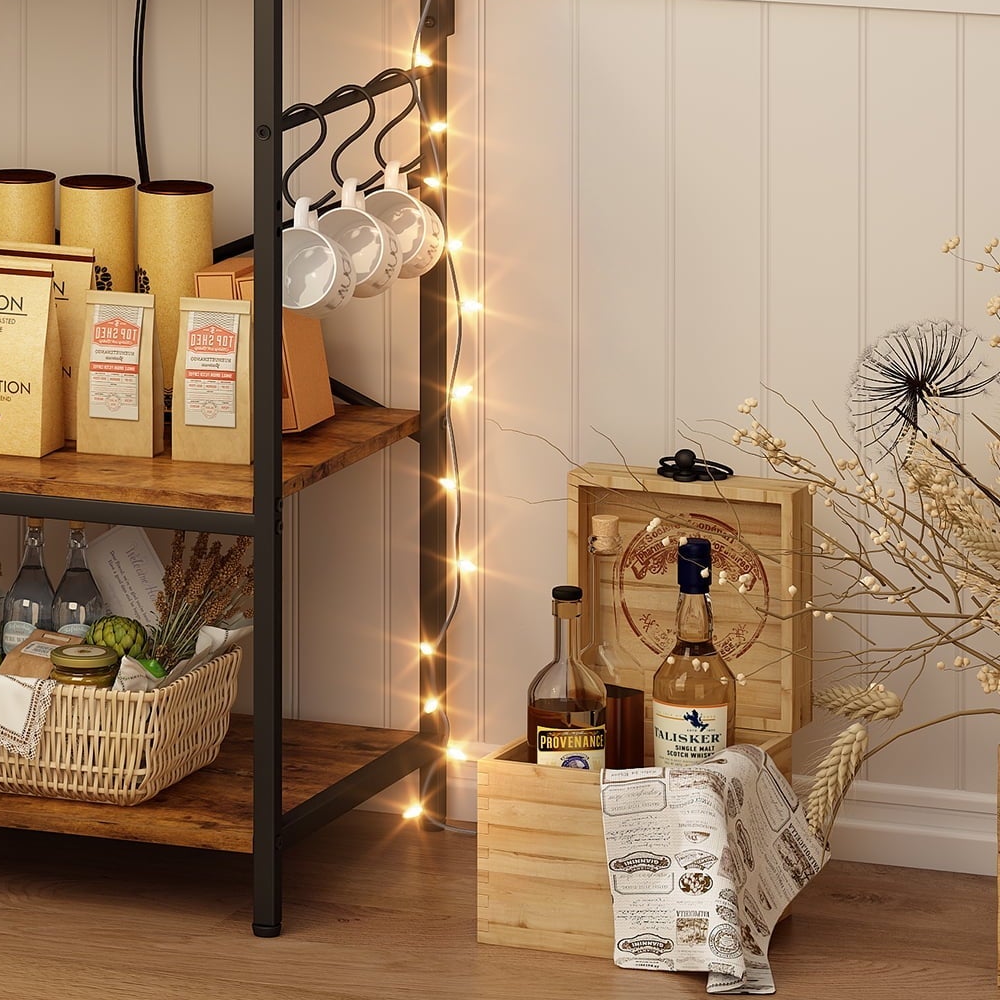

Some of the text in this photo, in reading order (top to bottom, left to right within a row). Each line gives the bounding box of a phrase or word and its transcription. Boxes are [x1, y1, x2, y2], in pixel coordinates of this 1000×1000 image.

[654, 726, 720, 744] TALISKER
[540, 733, 604, 750] PROVENANCE
[666, 750, 689, 758] SCOTCH
[675, 744, 697, 752] SINGLE
